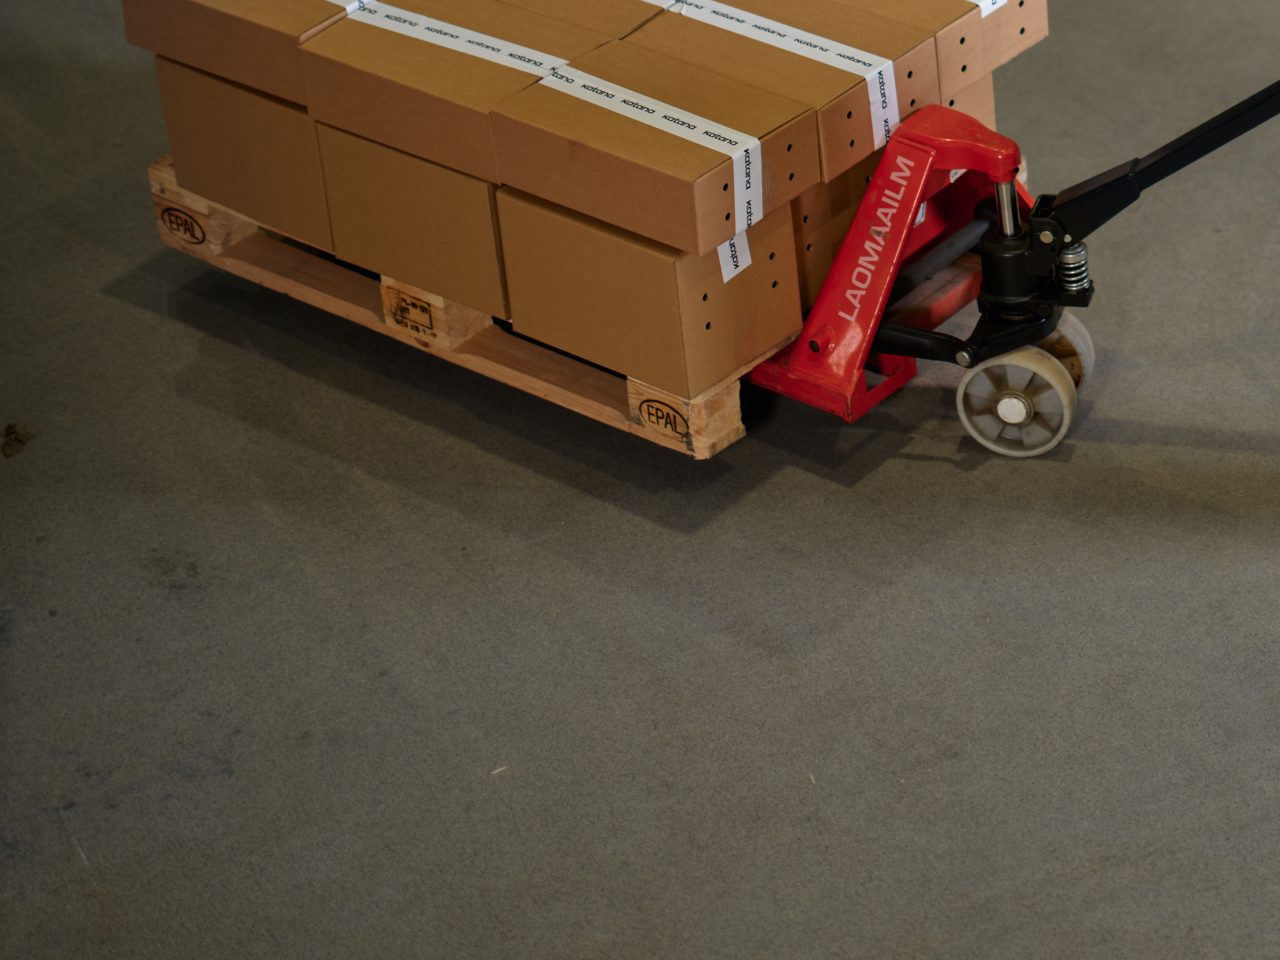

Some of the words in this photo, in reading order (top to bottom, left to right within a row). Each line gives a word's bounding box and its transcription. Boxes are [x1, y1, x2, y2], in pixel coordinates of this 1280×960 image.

[384, 14, 418, 27] katana
[425, 26, 460, 40] katana
[466, 39, 502, 53] katana
[508, 53, 543, 67] katana
[711, 10, 745, 24] katana
[752, 24, 786, 38] katana
[794, 38, 829, 53] katana
[836, 53, 872, 68] katana
[878, 70, 887, 109] katana
[580, 84, 615, 99] katana
[620, 99, 656, 115] katana
[661, 114, 697, 131] katana
[702, 130, 739, 146] katana
[744, 148, 752, 190] katana
[168, 212, 200, 241] EPAL
[838, 156, 915, 323] LAOMAAILM
[647, 404, 684, 436] EPAL
